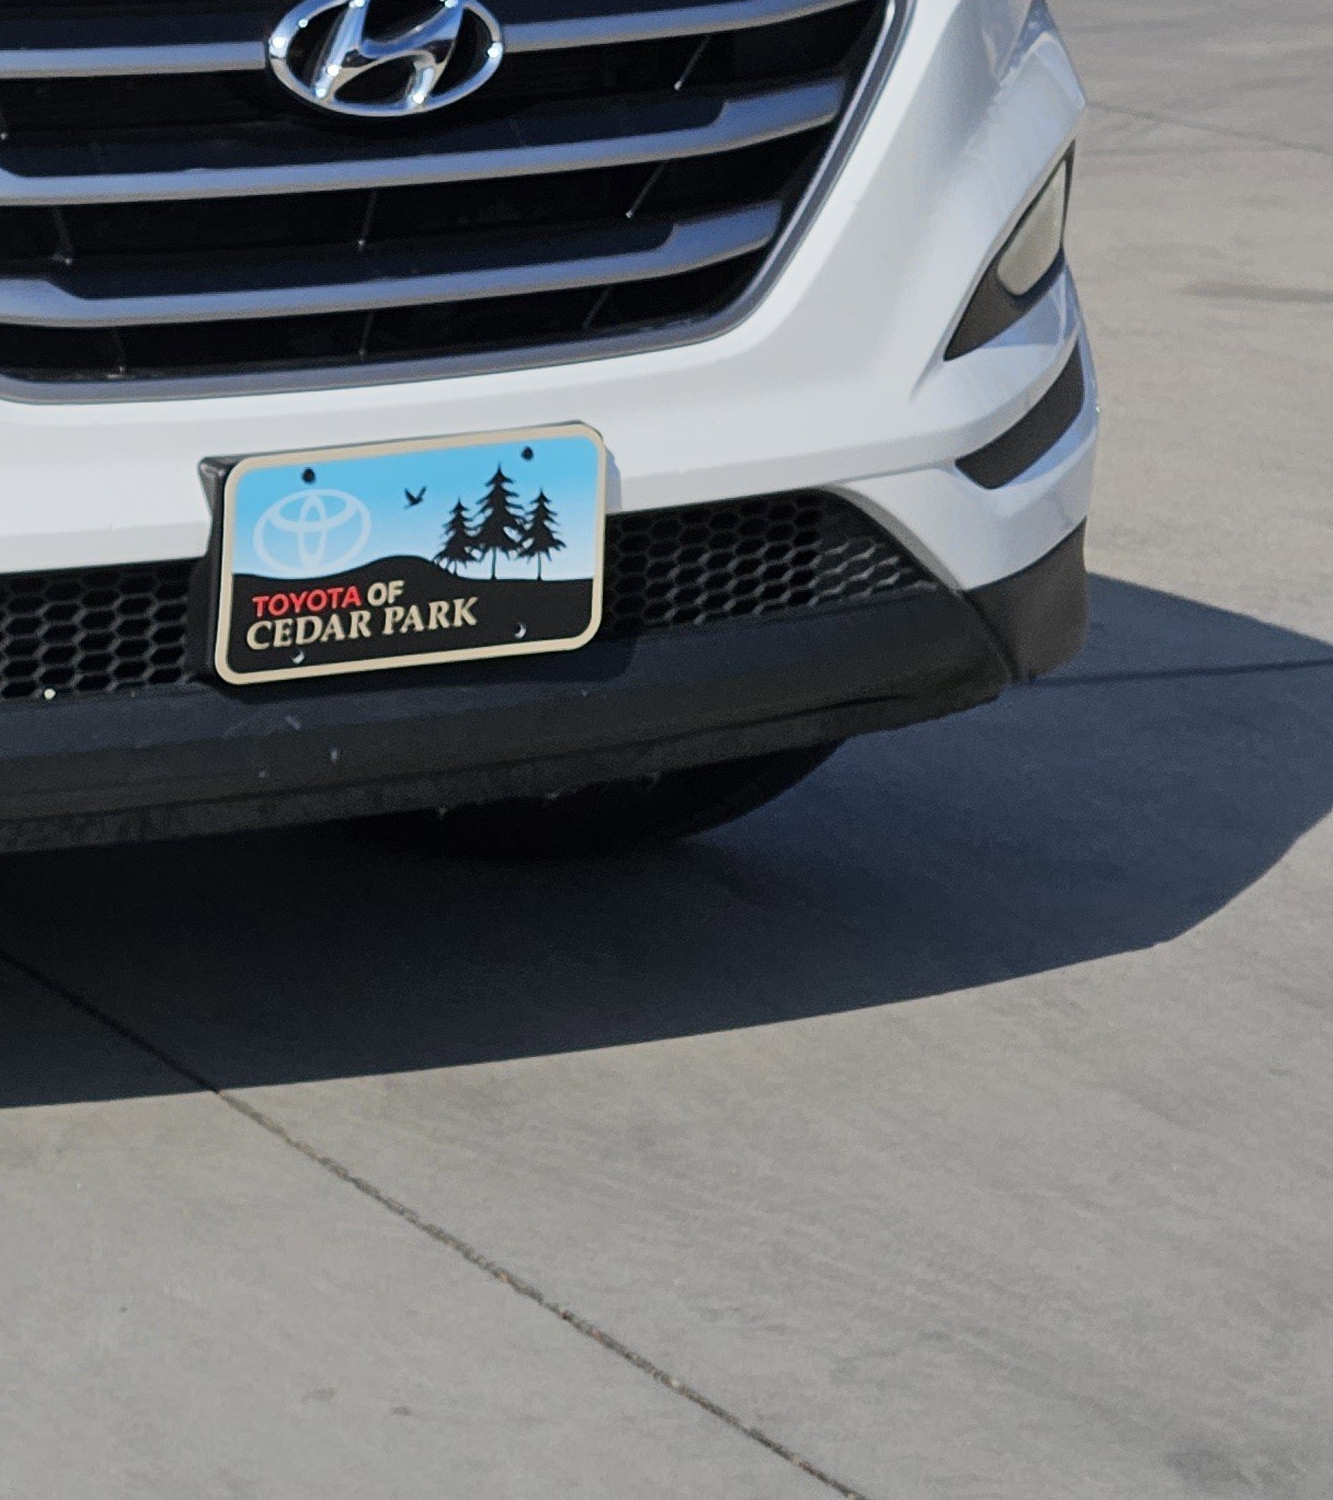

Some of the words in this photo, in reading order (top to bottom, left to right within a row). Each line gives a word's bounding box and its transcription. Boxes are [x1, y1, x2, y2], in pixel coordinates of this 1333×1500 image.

[252, 585, 362, 618] TOYOTA
[367, 580, 405, 607] OF
[246, 609, 372, 651] CEDAR
[381, 597, 479, 636] PARK
